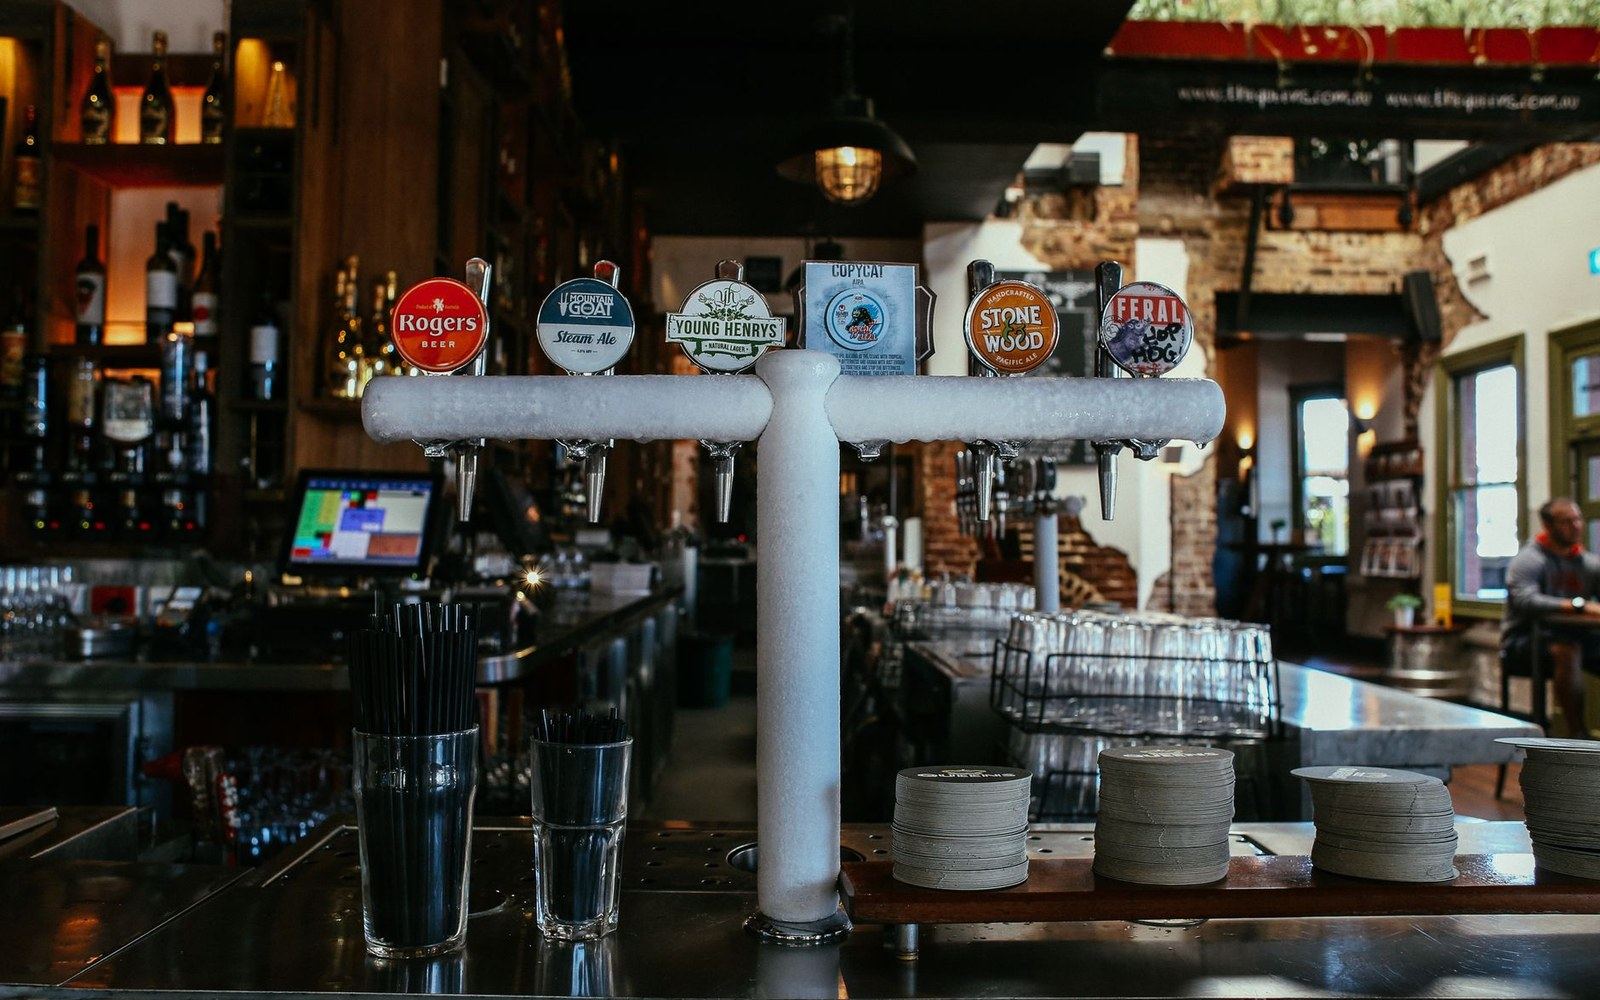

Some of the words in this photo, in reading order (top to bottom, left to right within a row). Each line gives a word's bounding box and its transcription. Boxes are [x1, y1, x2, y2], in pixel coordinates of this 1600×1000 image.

[832, 264, 884, 278] COPYCAT
[569, 294, 614, 304] MOUNTAIN
[986, 290, 1035, 305] HANDCRAFTED
[568, 301, 614, 316] GOAT
[1117, 298, 1181, 322] FERAL
[980, 305, 1041, 329] STONE
[676, 320, 720, 336] YOUNG
[724, 322, 777, 339] HENRYS
[421, 340, 456, 348] BEER
[553, 330, 595, 344] Steam
[596, 332, 617, 345] Ale
[983, 331, 1044, 353] WOOD
[730, 345, 746, 353] LAGER
[995, 355, 1023, 366] PACIFIC
[1026, 352, 1038, 363] ALE
